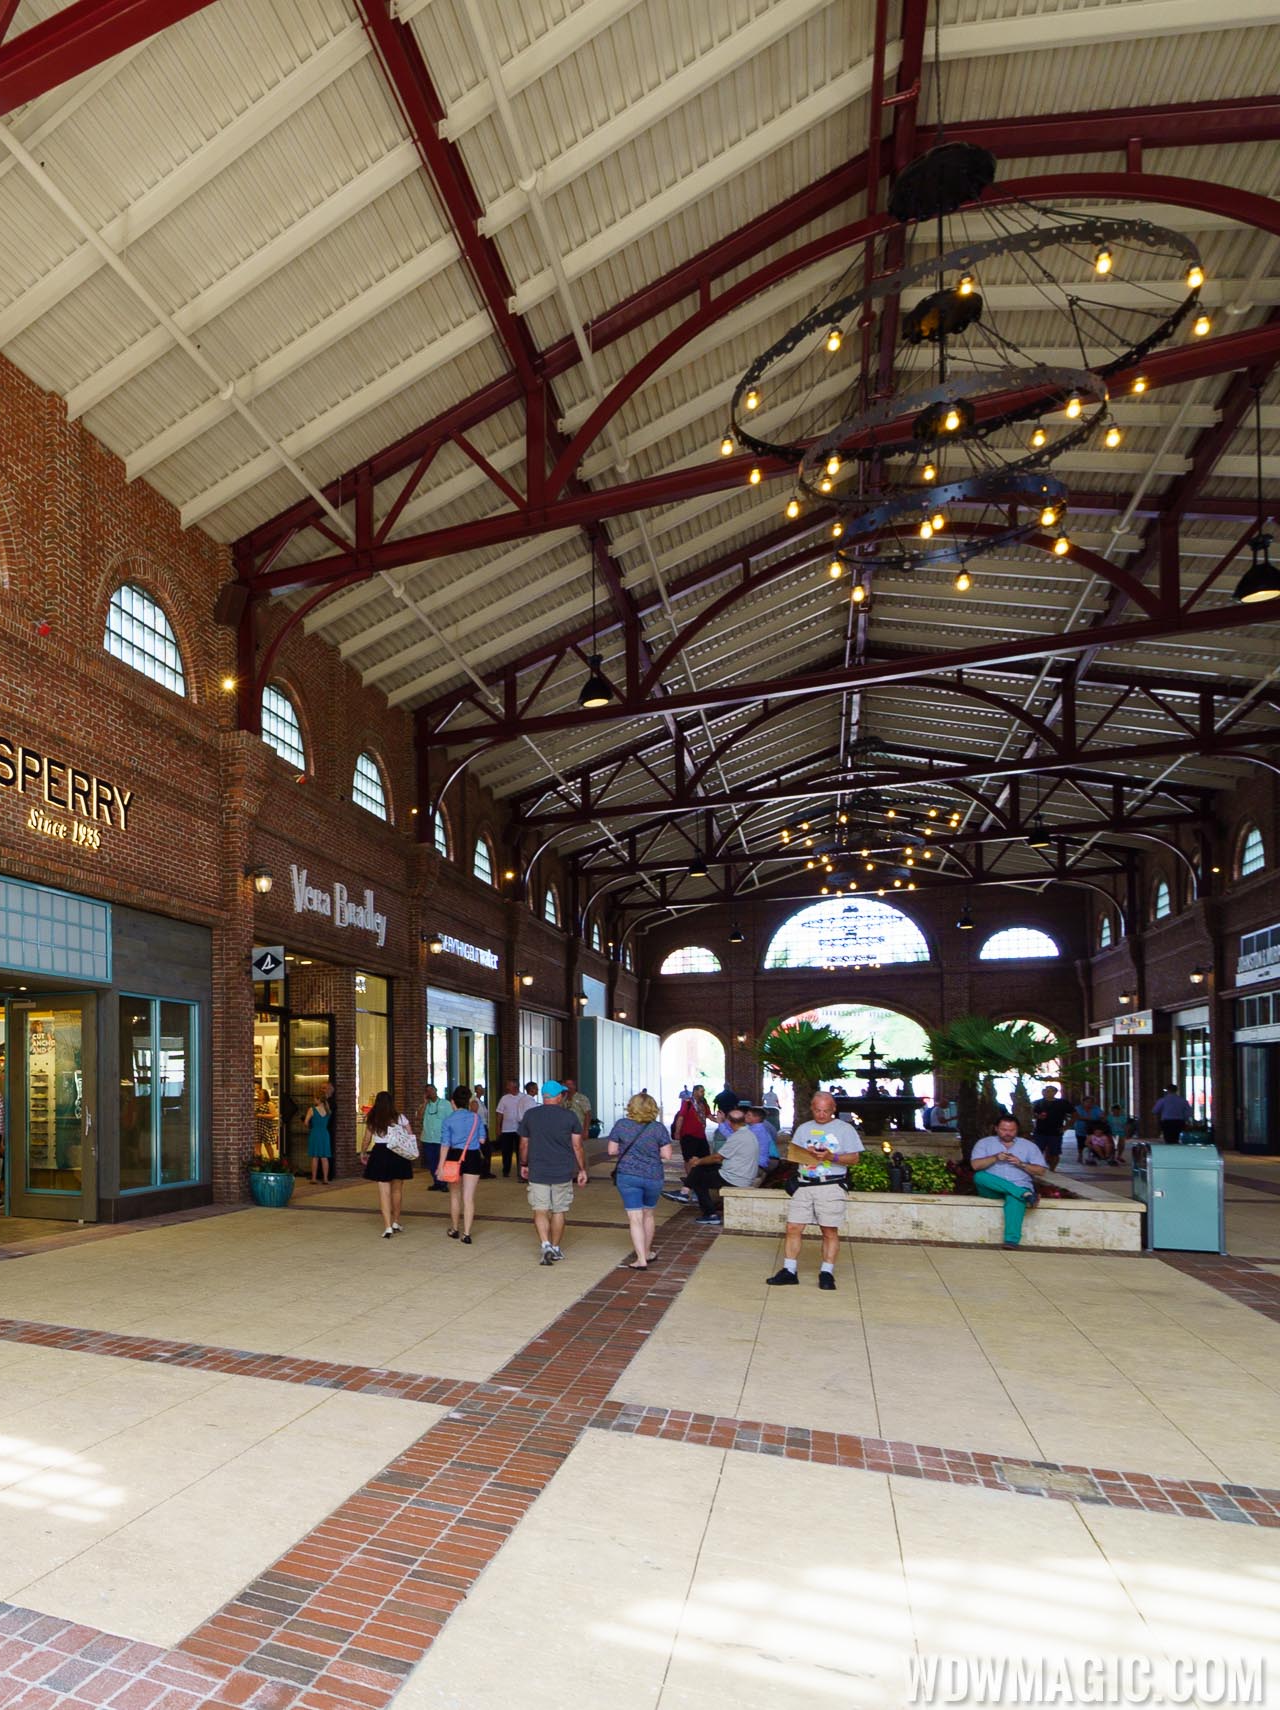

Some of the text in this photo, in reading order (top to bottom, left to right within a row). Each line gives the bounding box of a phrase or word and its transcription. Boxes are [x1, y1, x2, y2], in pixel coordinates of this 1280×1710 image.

[27, 808, 102, 849] Since 1935
[289, 864, 387, 947] Vera Bradley
